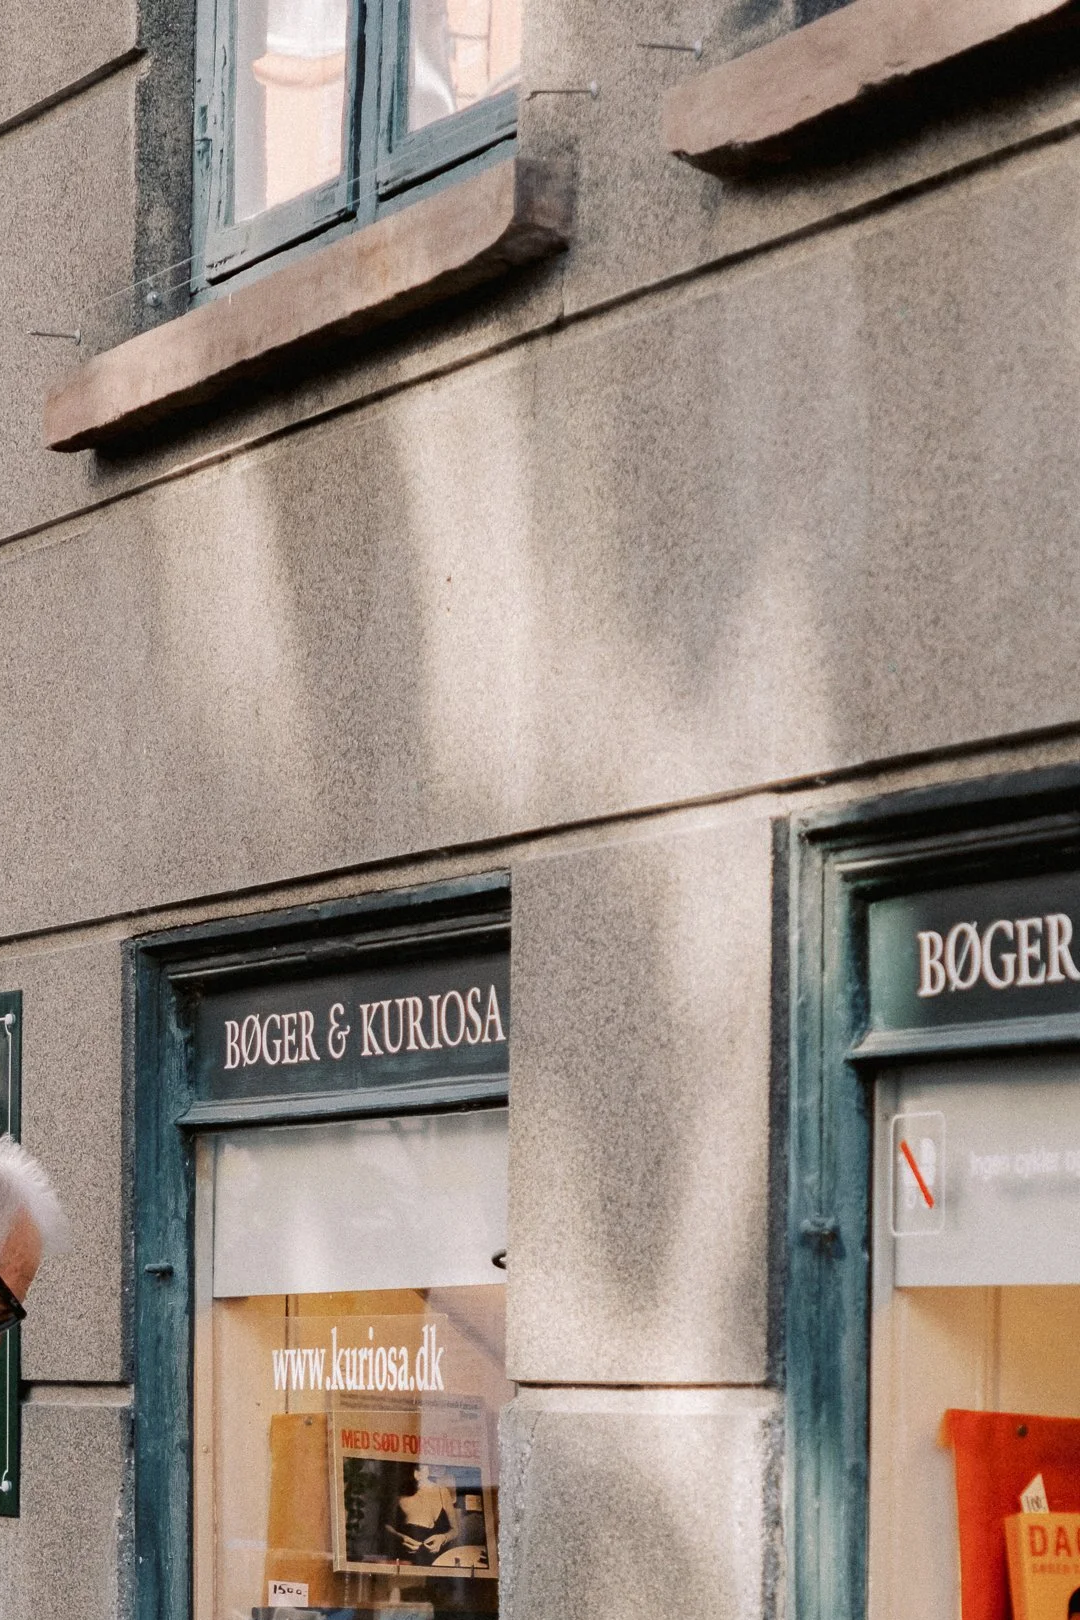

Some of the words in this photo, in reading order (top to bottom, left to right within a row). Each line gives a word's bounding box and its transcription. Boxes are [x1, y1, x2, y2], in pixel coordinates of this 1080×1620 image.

[916, 912, 1080, 998] BØGER
[223, 1010, 321, 1069] BØGER
[327, 1002, 351, 1059] &
[360, 984, 507, 1056] KURIOSA
[271, 1324, 446, 1392] www.kuriosa.dk
[341, 1428, 370, 1450] MED
[373, 1431, 400, 1453] SØD
